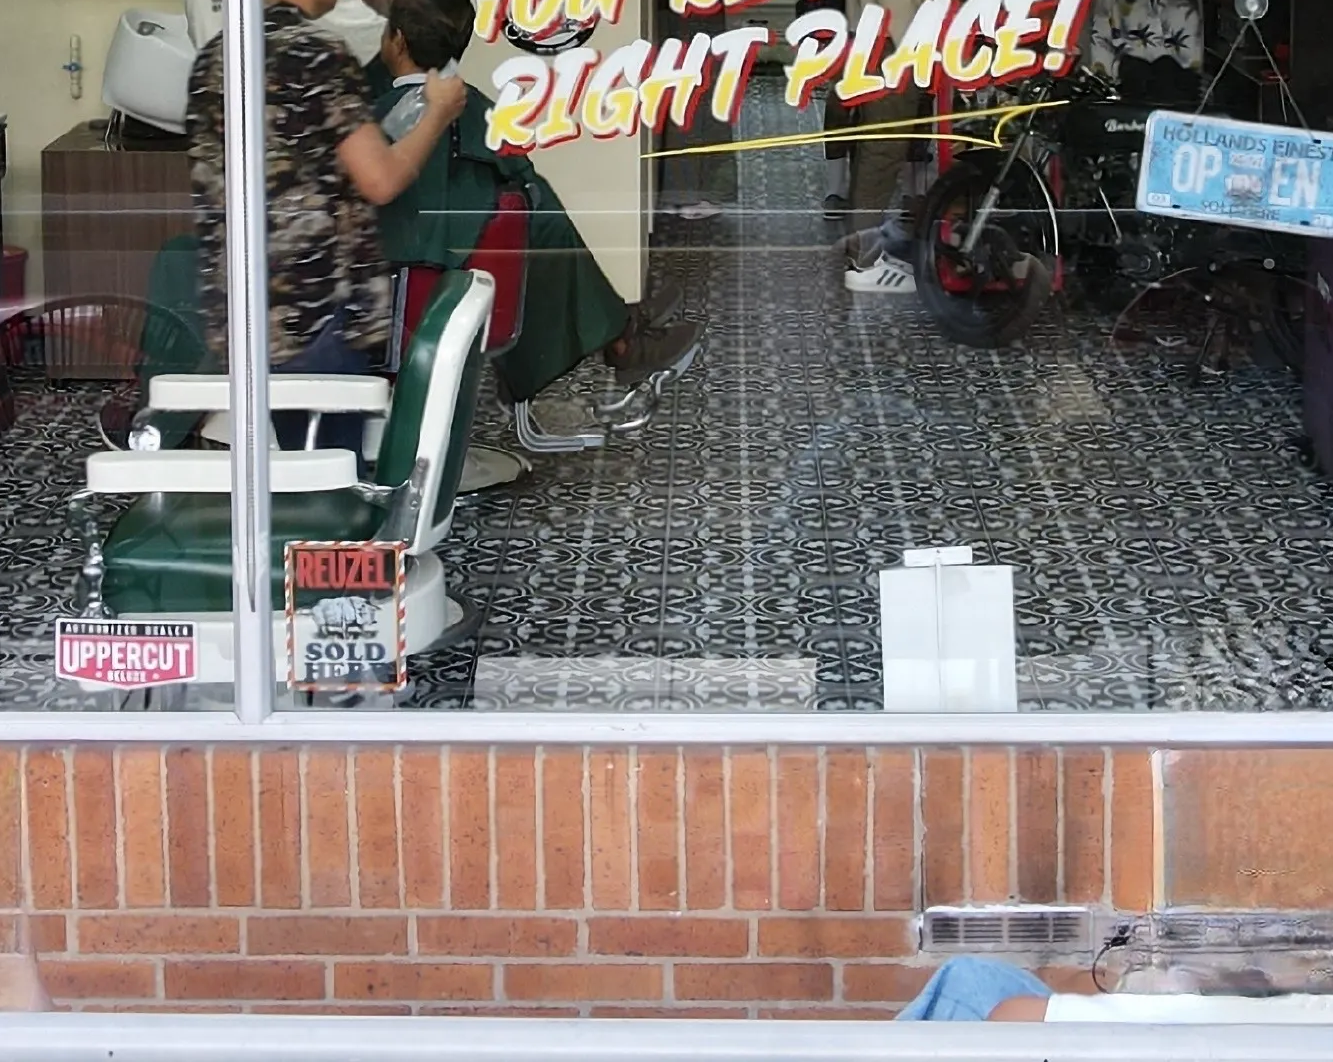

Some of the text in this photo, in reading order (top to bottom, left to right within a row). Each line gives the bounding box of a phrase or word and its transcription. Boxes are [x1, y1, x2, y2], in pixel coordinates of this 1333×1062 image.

[484, 26, 774, 157] RIGHT
[1163, 125, 1266, 154] HOLLANDS
[296, 549, 392, 590] REUZEL
[62, 639, 190, 677] UPPERCUT
[304, 642, 386, 662] SOLD
